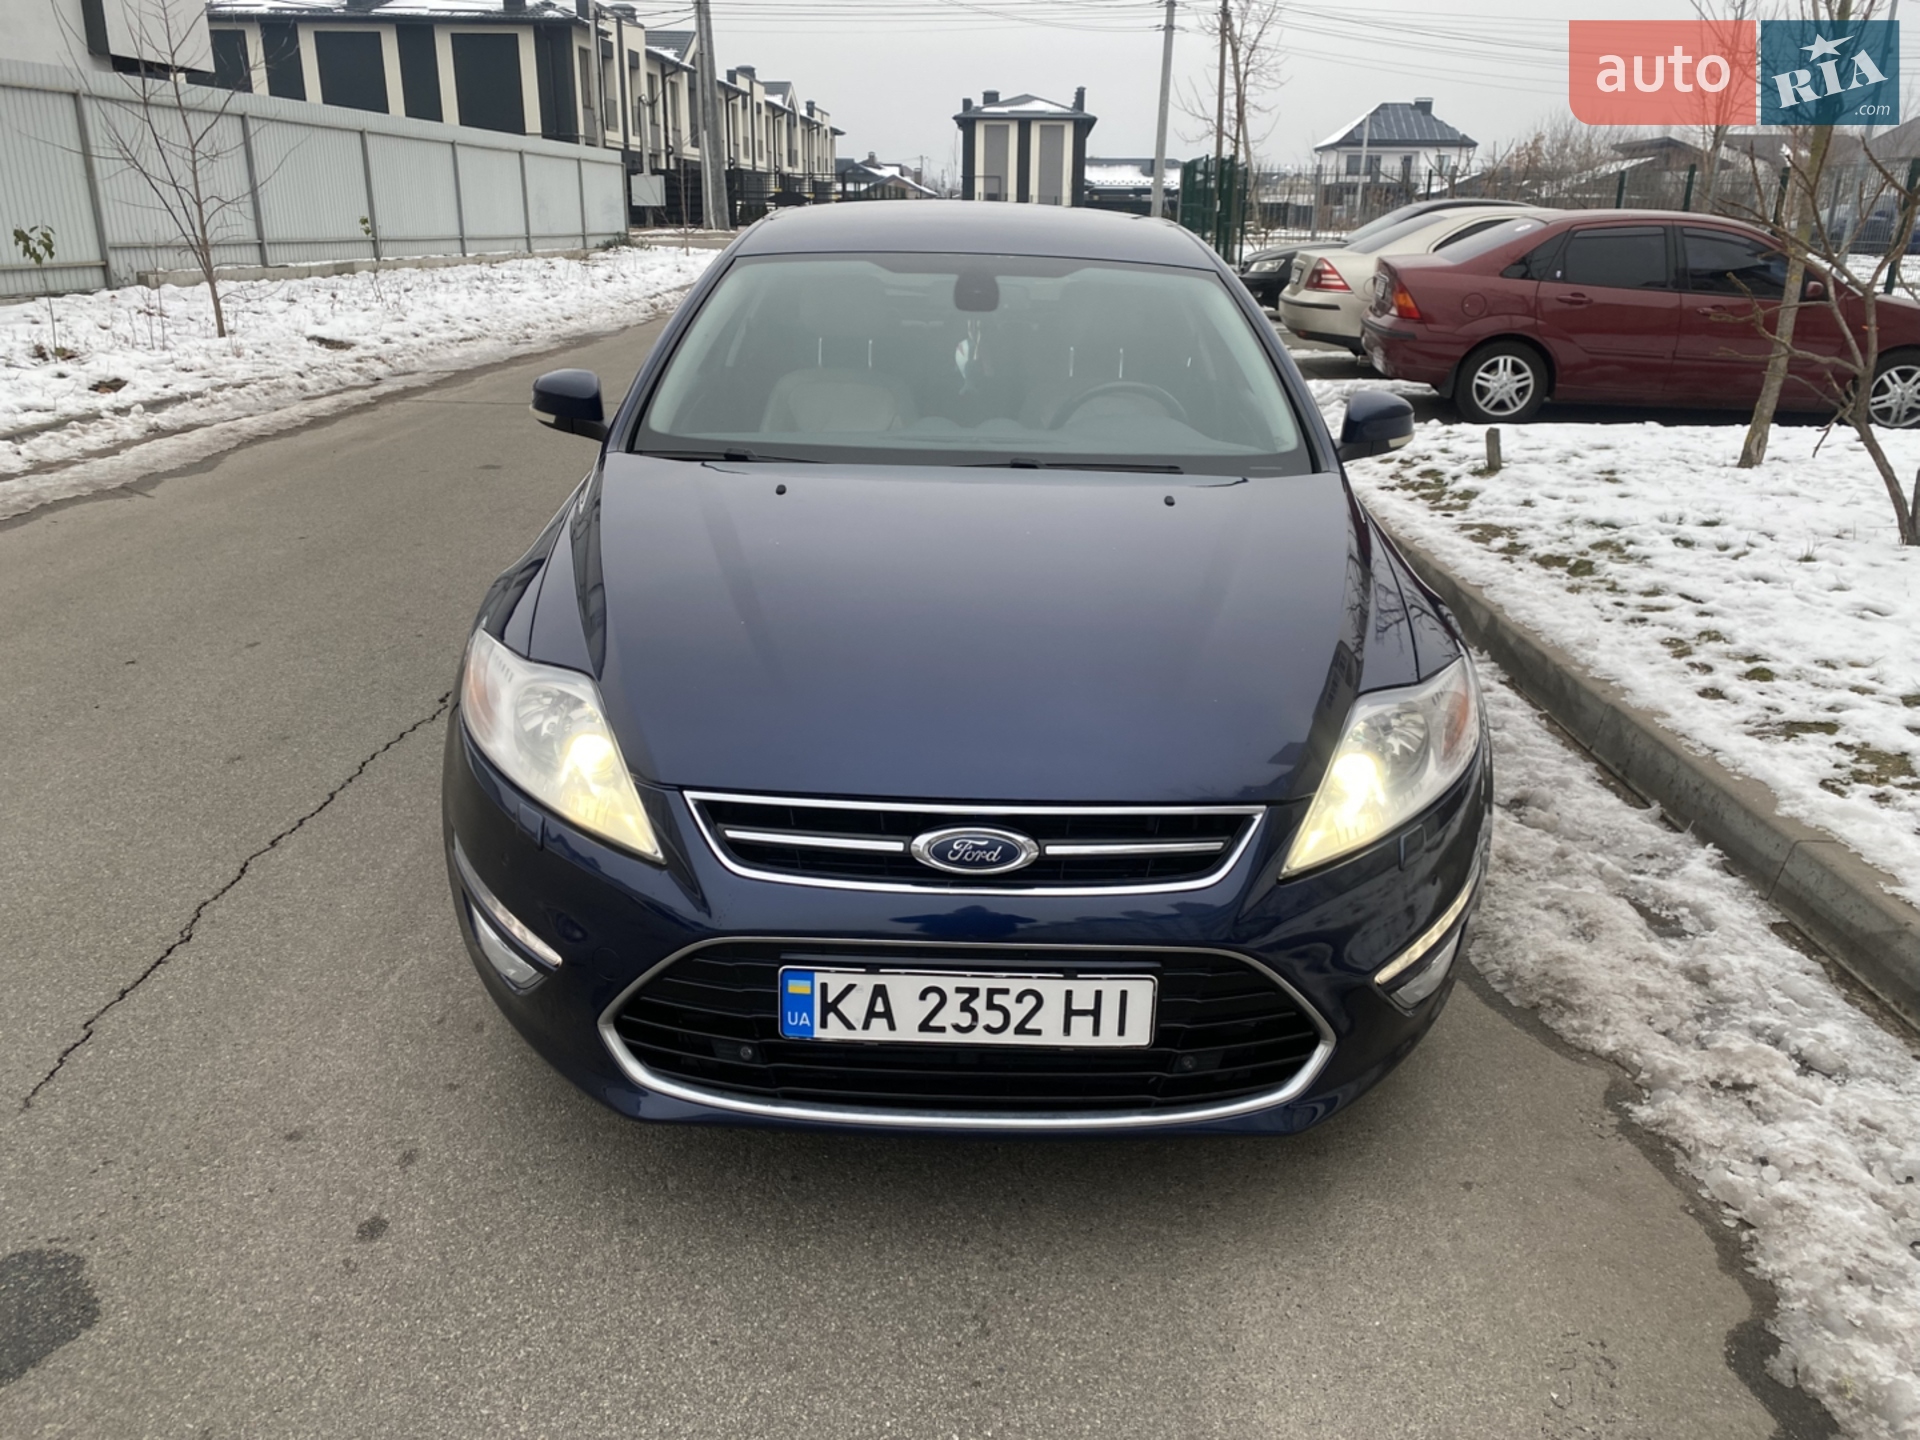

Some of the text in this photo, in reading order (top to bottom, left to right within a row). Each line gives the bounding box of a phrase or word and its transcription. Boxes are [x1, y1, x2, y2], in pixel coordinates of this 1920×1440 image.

[947, 838, 1003, 862] Ford
[787, 1011, 811, 1027] UA
[819, 982, 1128, 1037] KA 2352 HI
